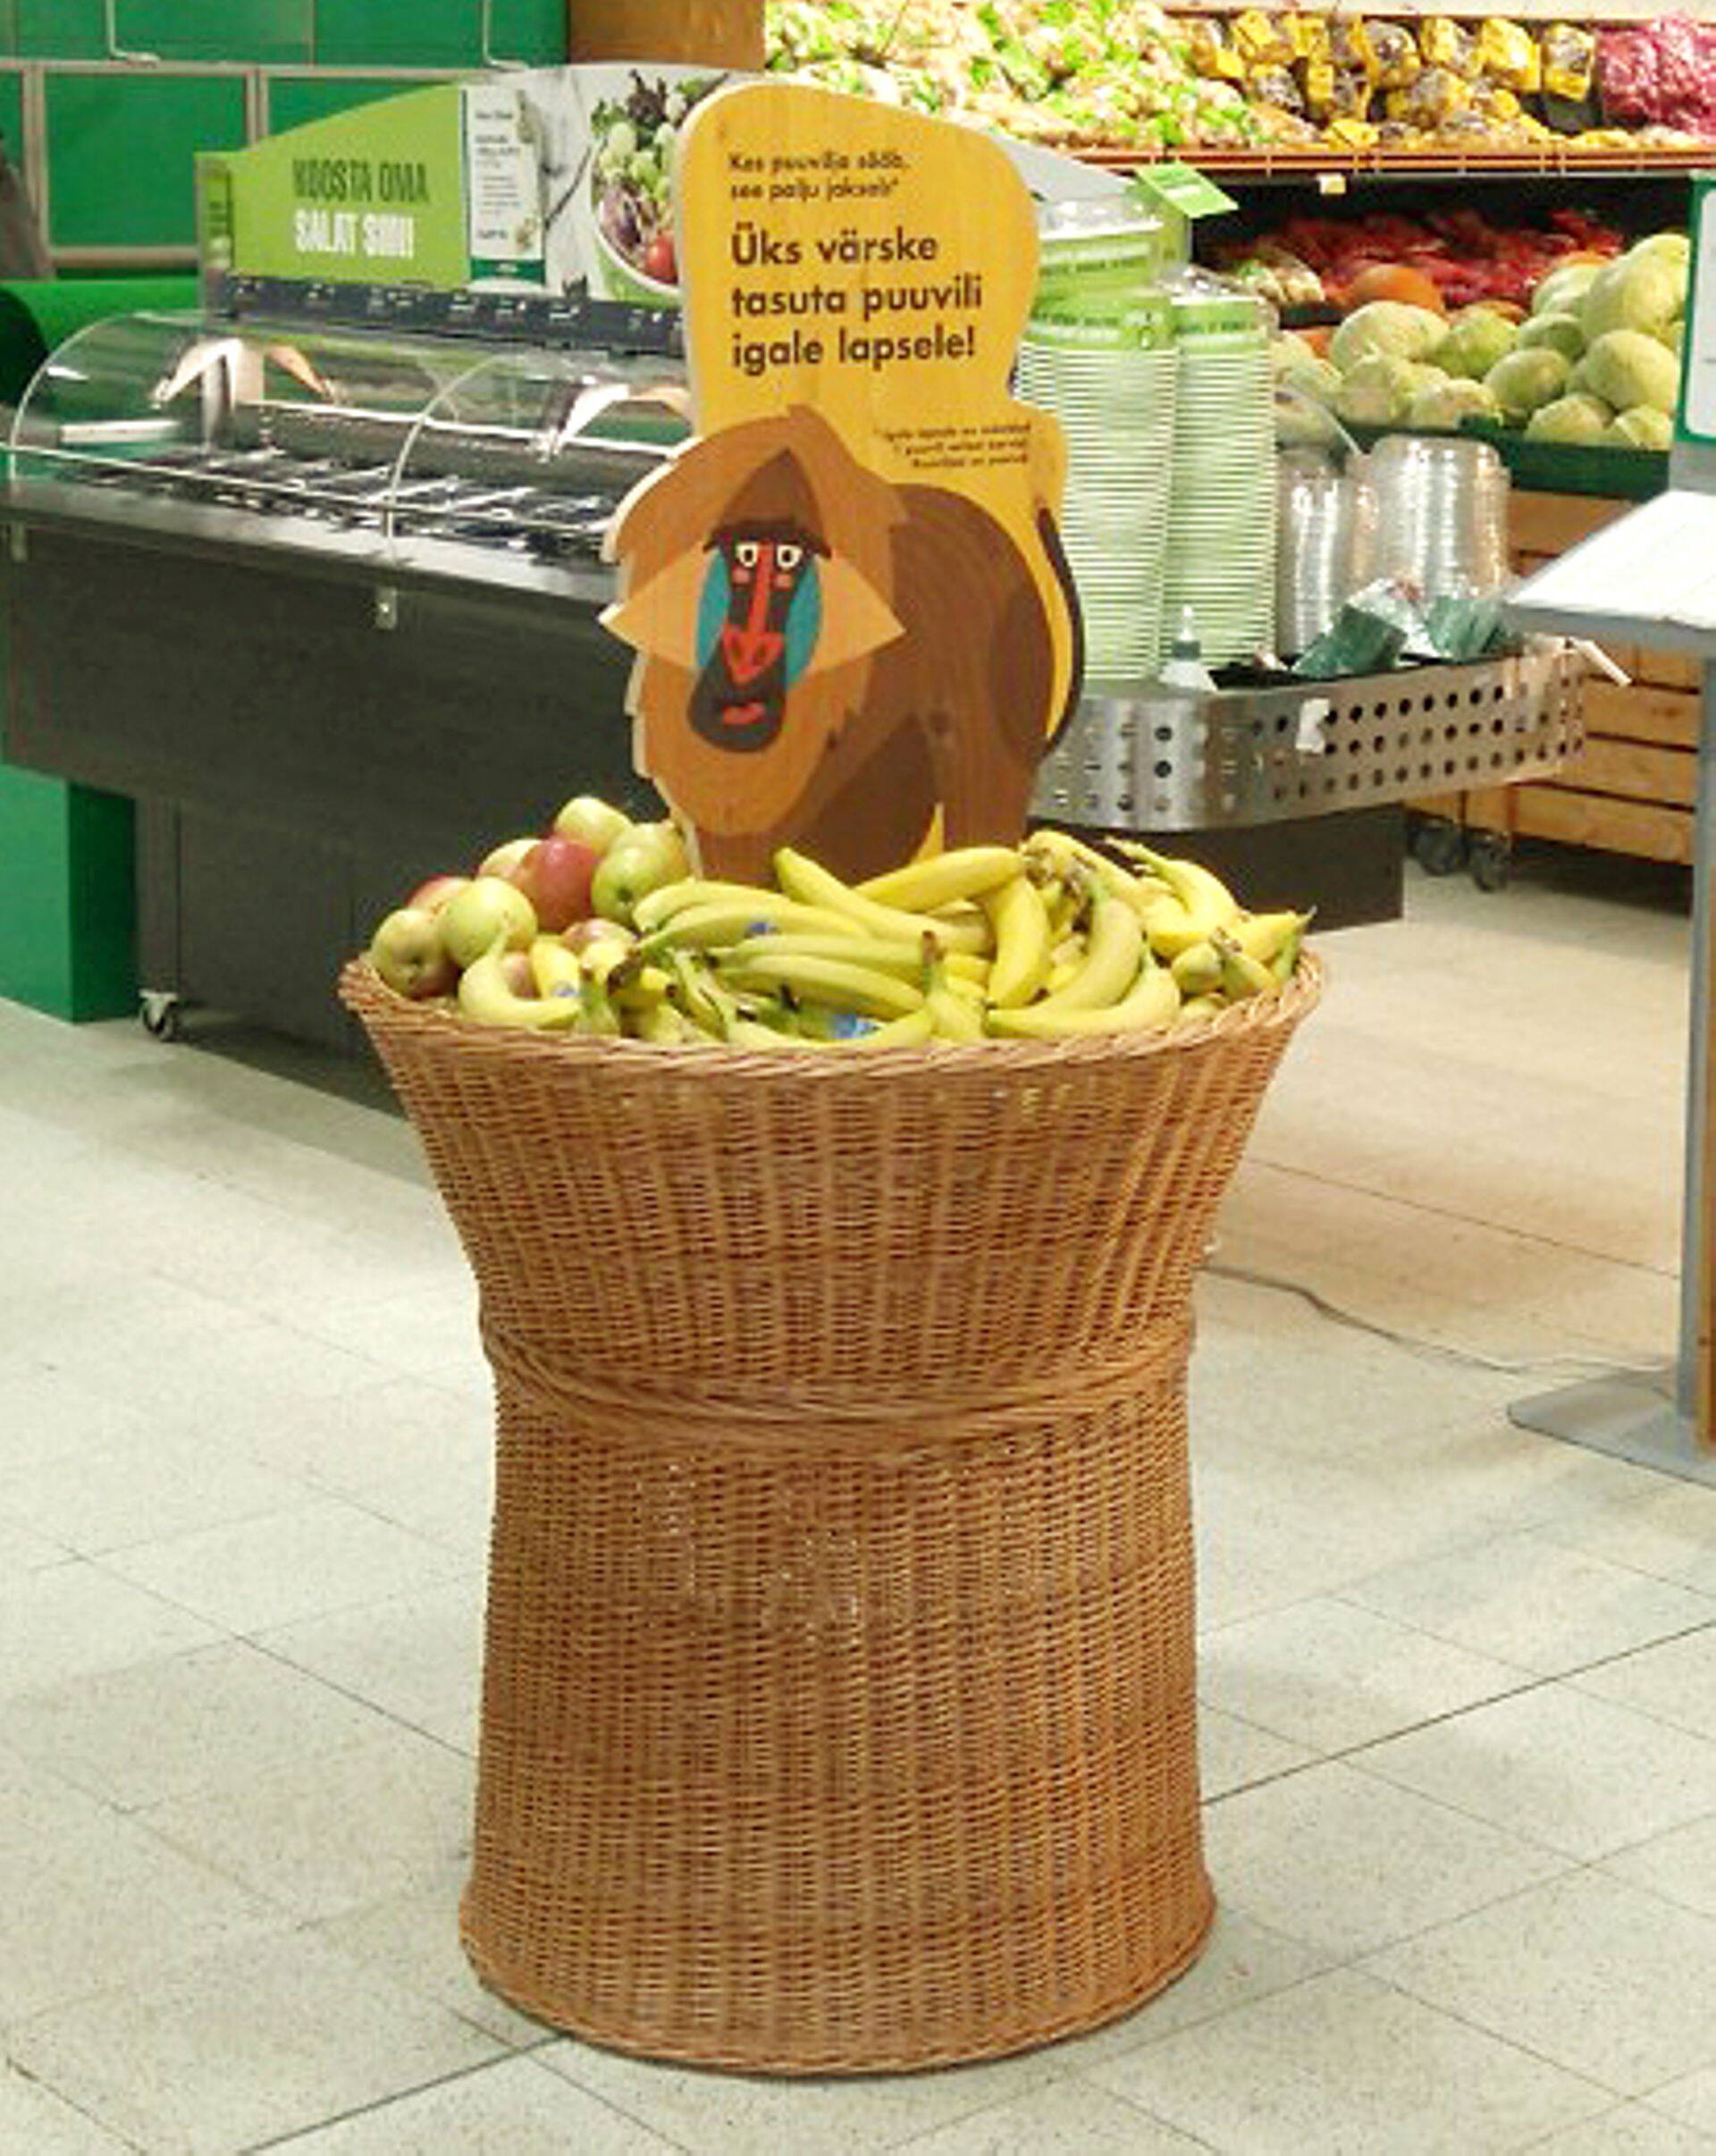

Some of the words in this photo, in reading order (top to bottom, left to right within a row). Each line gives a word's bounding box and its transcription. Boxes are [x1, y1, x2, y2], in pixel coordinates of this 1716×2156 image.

[380, 160, 431, 204] OMA
[728, 152, 764, 171] Kes
[771, 149, 849, 175] puuvilja
[731, 183, 763, 199] see
[770, 178, 820, 203] palju
[295, 209, 357, 257] SALAT
[731, 221, 802, 266] Üks
[816, 225, 938, 264] värske
[731, 284, 846, 317] tasuta
[863, 272, 982, 323] puuvili
[731, 329, 824, 377] igale
[838, 322, 975, 373] lapsele!
